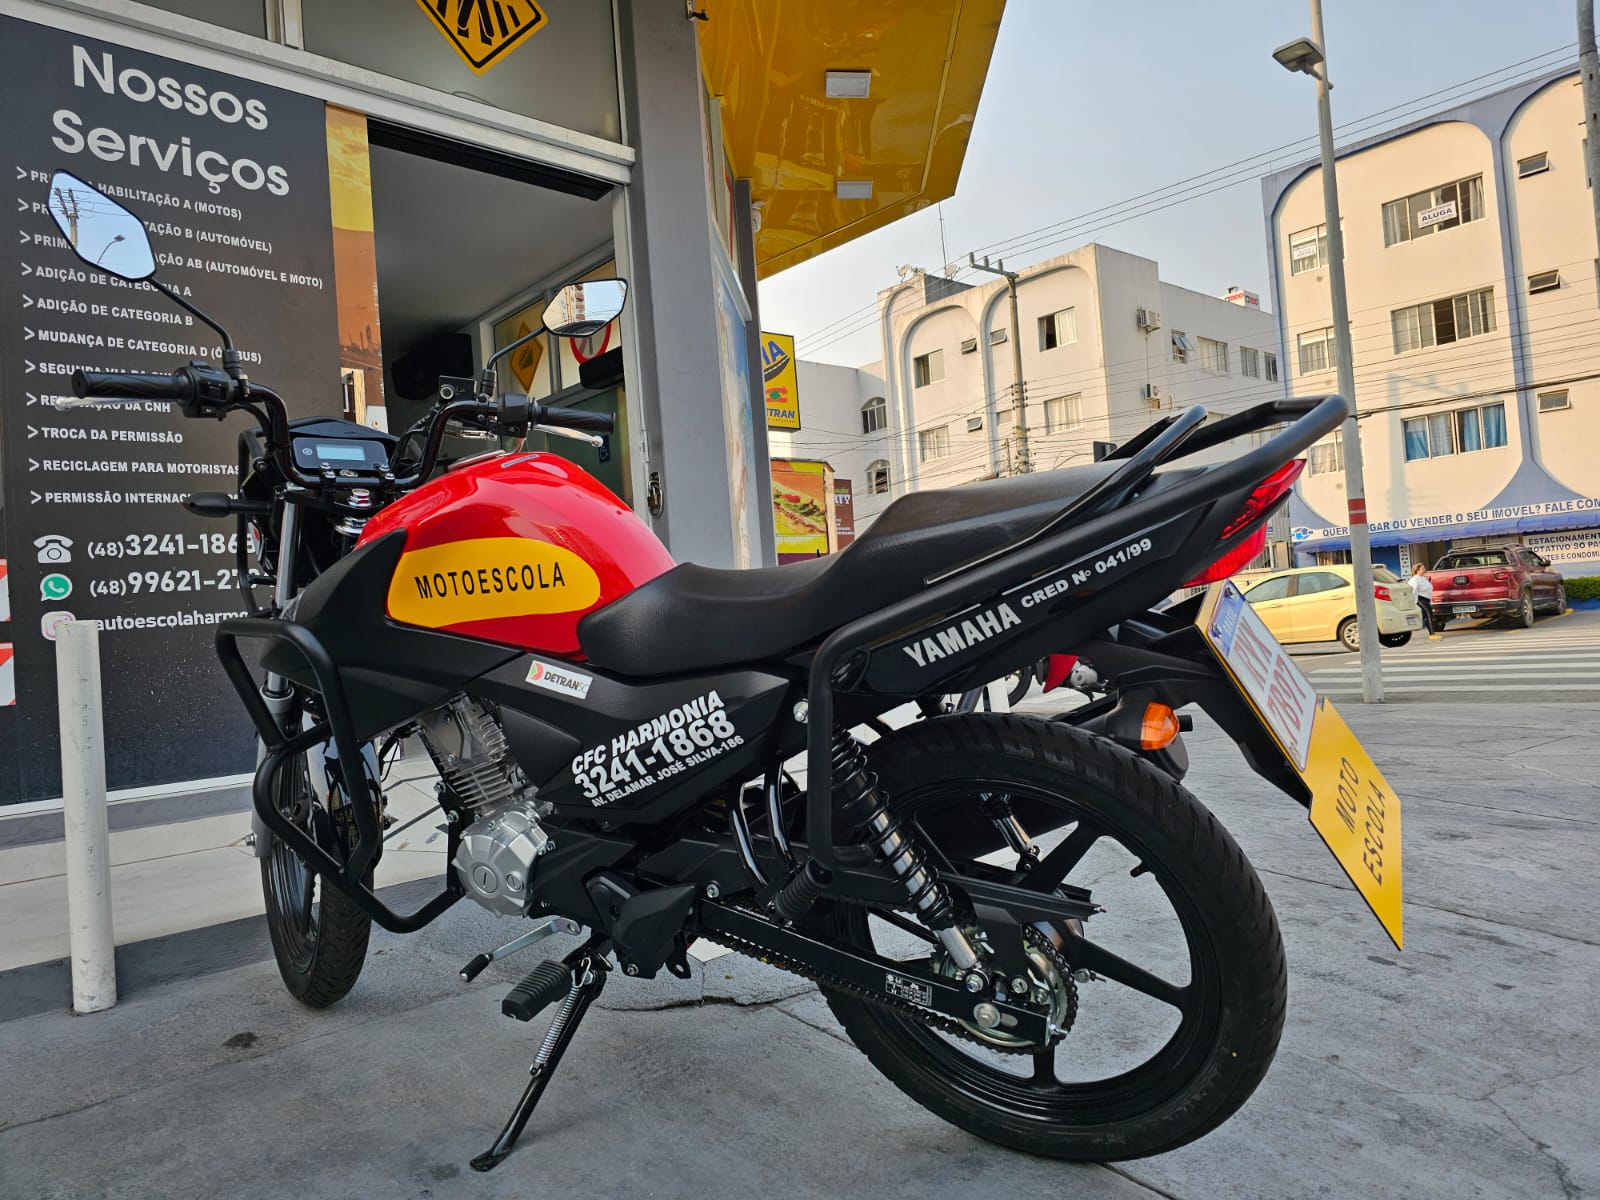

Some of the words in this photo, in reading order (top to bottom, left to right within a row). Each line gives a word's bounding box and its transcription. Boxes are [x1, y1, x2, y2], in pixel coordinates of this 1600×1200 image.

[51, 109, 290, 196] Serviços
[98, 183, 180, 207] HABILITAÇÃO
[183, 199, 192, 210] A
[194, 201, 242, 221] (MOTOS)
[1422, 208, 1453, 221] ALUGA
[185, 228, 193, 239] B
[196, 229, 273, 254] (AUTOMÓVEL)
[36, 266, 86, 282] ADIÇÃO
[90, 273, 107, 285] DE
[183, 286, 192, 297] A
[187, 257, 203, 269] AB
[205, 258, 278, 281] (AUTOMÓVEL
[280, 272, 287, 282] E
[289, 273, 323, 289] MOTO)
[37, 297, 87, 314] ADIÇÃO
[91, 304, 108, 316] DE
[112, 306, 182, 325] CATEGORIA
[185, 316, 193, 326] B
[38, 329, 104, 347] MUDANÇA
[107, 336, 124, 348] DE
[128, 339, 197, 356] CATEGORIA
[200, 347, 208, 357] D
[211, 346, 262, 365] (ÔBUS)
[145, 401, 171, 413] CNH
[41, 427, 87, 440] TROCA
[90, 429, 108, 440] DA
[112, 430, 183, 443] PERMISSÃO
[43, 460, 128, 472] RECICLAGEM
[132, 461, 164, 473] PARA
[45, 491, 122, 503] PERMISSÃO
[1322, 527, 1348, 537] QUER
[1393, 520, 1407, 529] OU
[1410, 514, 1453, 528] VENDER
[1456, 513, 1464, 522] O
[1466, 510, 1488, 521] SEU
[1545, 501, 1574, 513] FALE
[415, 562, 566, 599] MOTOESCOLA
[1021, 579, 1069, 608] CRED
[1094, 538, 1152, 575] 041/99
[902, 602, 1023, 669] YAMAHA
[1267, 654, 1307, 746] 7B97
[571, 744, 607, 775] CFC
[611, 689, 725, 759] HARMONIA
[574, 709, 736, 799] 3241-1868
[591, 795, 608, 808] AV.
[607, 775, 657, 803] DELAMAR
[656, 759, 687, 782] JOSÉ
[687, 735, 745, 768] SILVA-186
[1335, 756, 1359, 835] MOTO
[1362, 779, 1386, 887] ESCOLA
